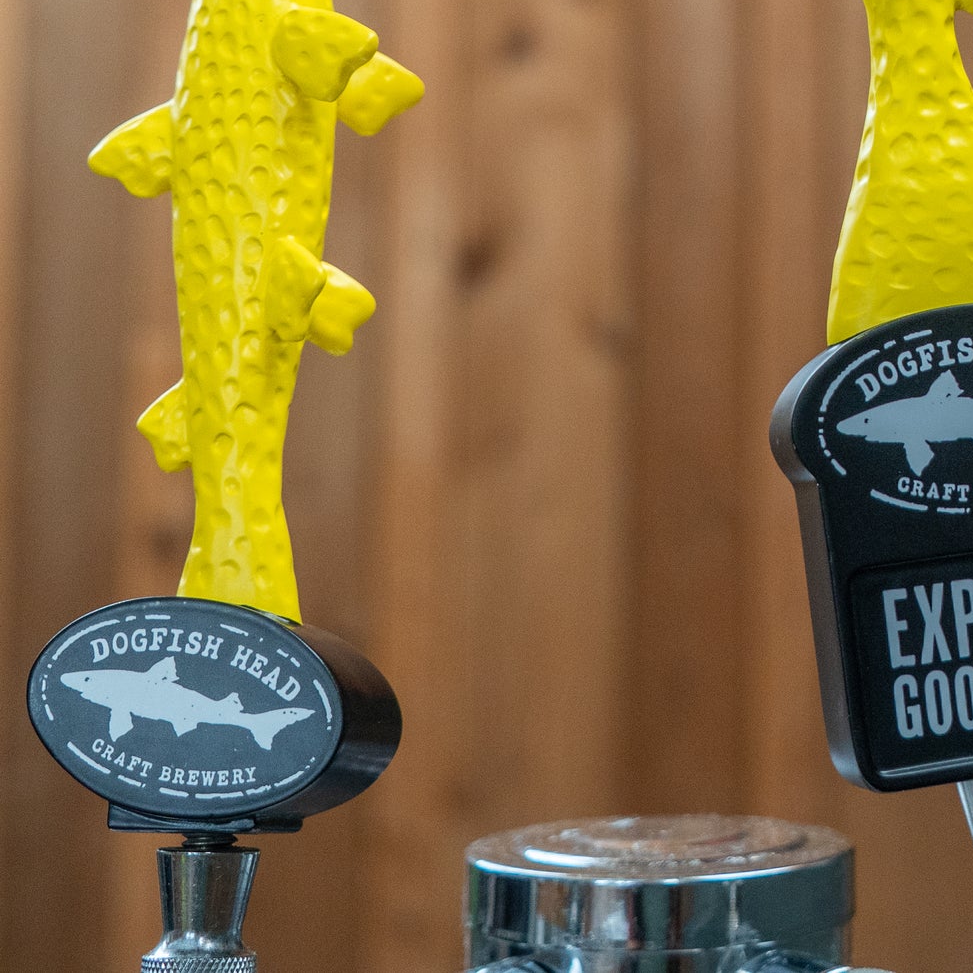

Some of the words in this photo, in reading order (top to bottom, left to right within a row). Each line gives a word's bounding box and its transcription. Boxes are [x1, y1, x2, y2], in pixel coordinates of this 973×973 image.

[897, 476, 970, 503] CRAFT
[90, 627, 223, 663] DOGFISH
[230, 644, 301, 702] HEAD
[91, 738, 152, 777] CRAFT
[158, 766, 257, 787] BREWERY
